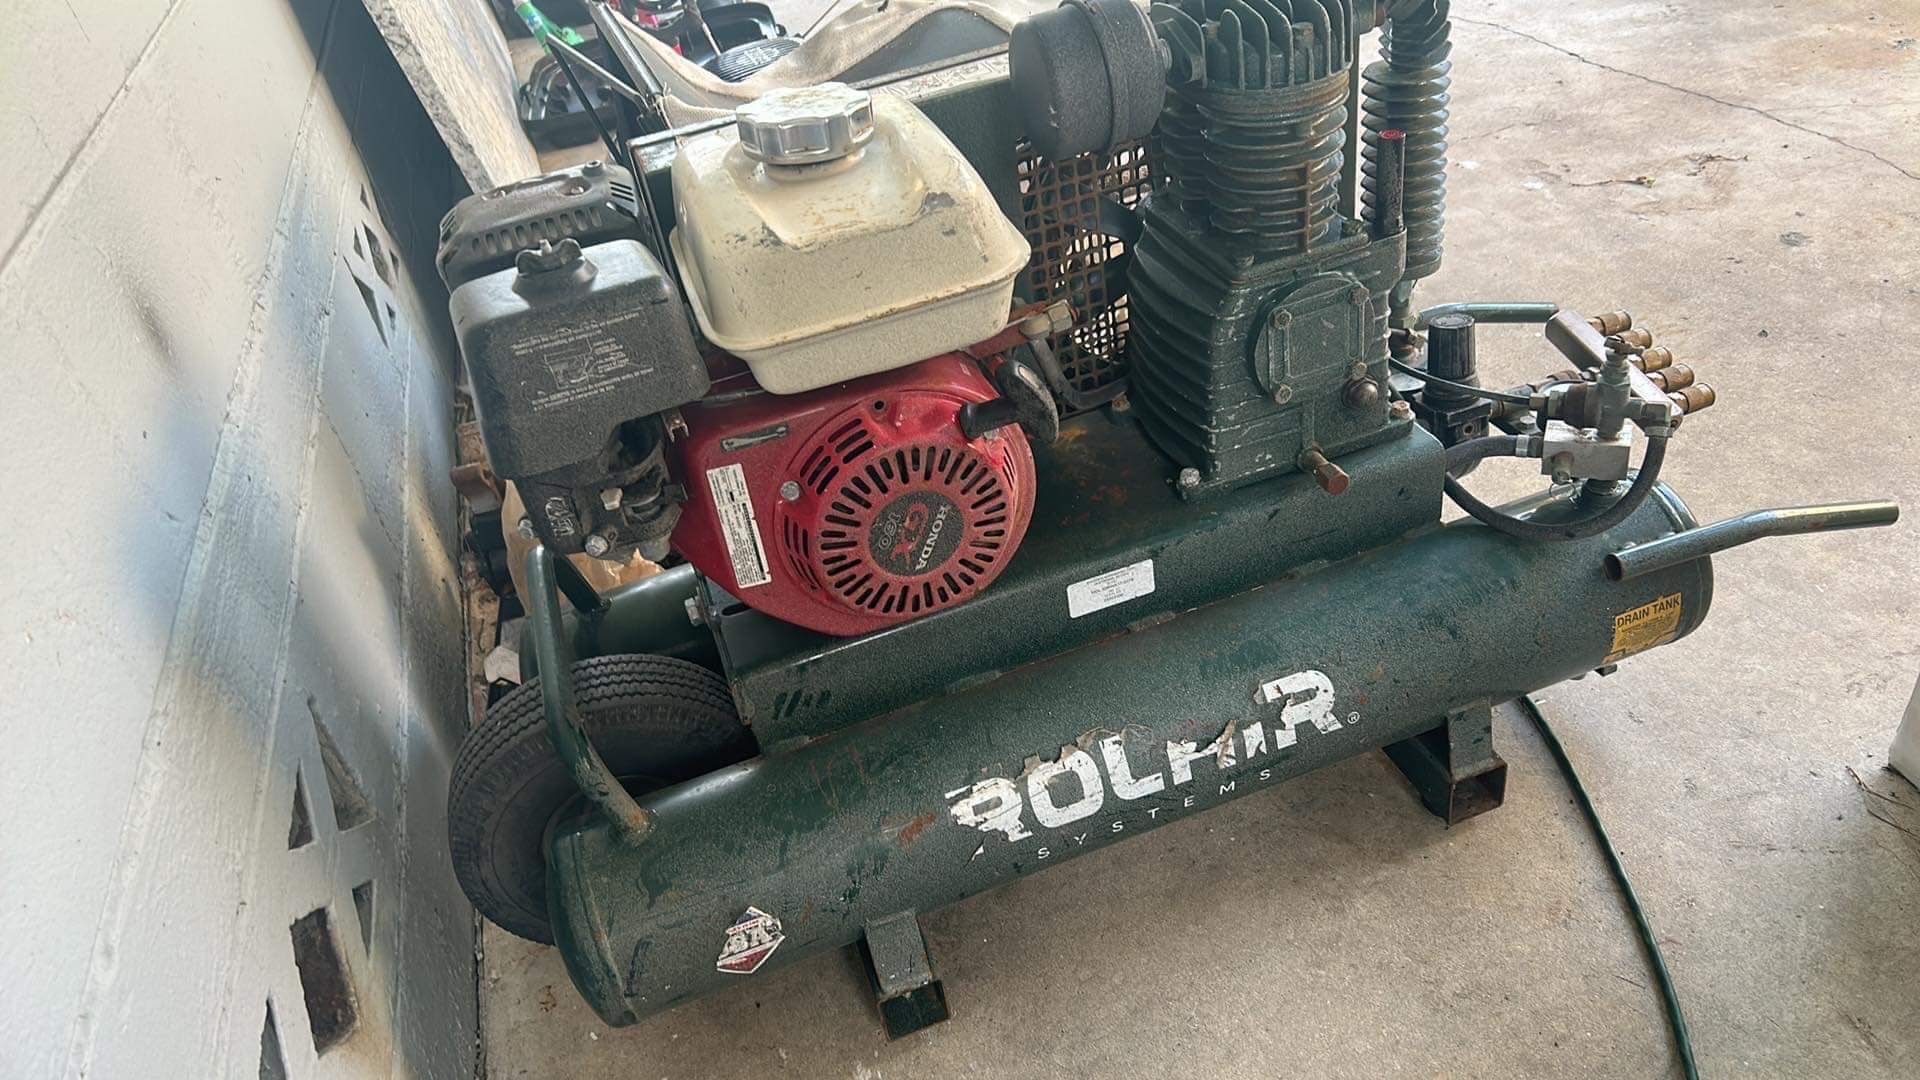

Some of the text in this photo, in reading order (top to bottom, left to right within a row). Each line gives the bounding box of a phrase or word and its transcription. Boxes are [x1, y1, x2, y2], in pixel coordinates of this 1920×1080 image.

[914, 505, 951, 571] HONDA
[1617, 595, 1681, 626] DRAIN TANK
[1037, 768, 1271, 860] SYSTEMS
